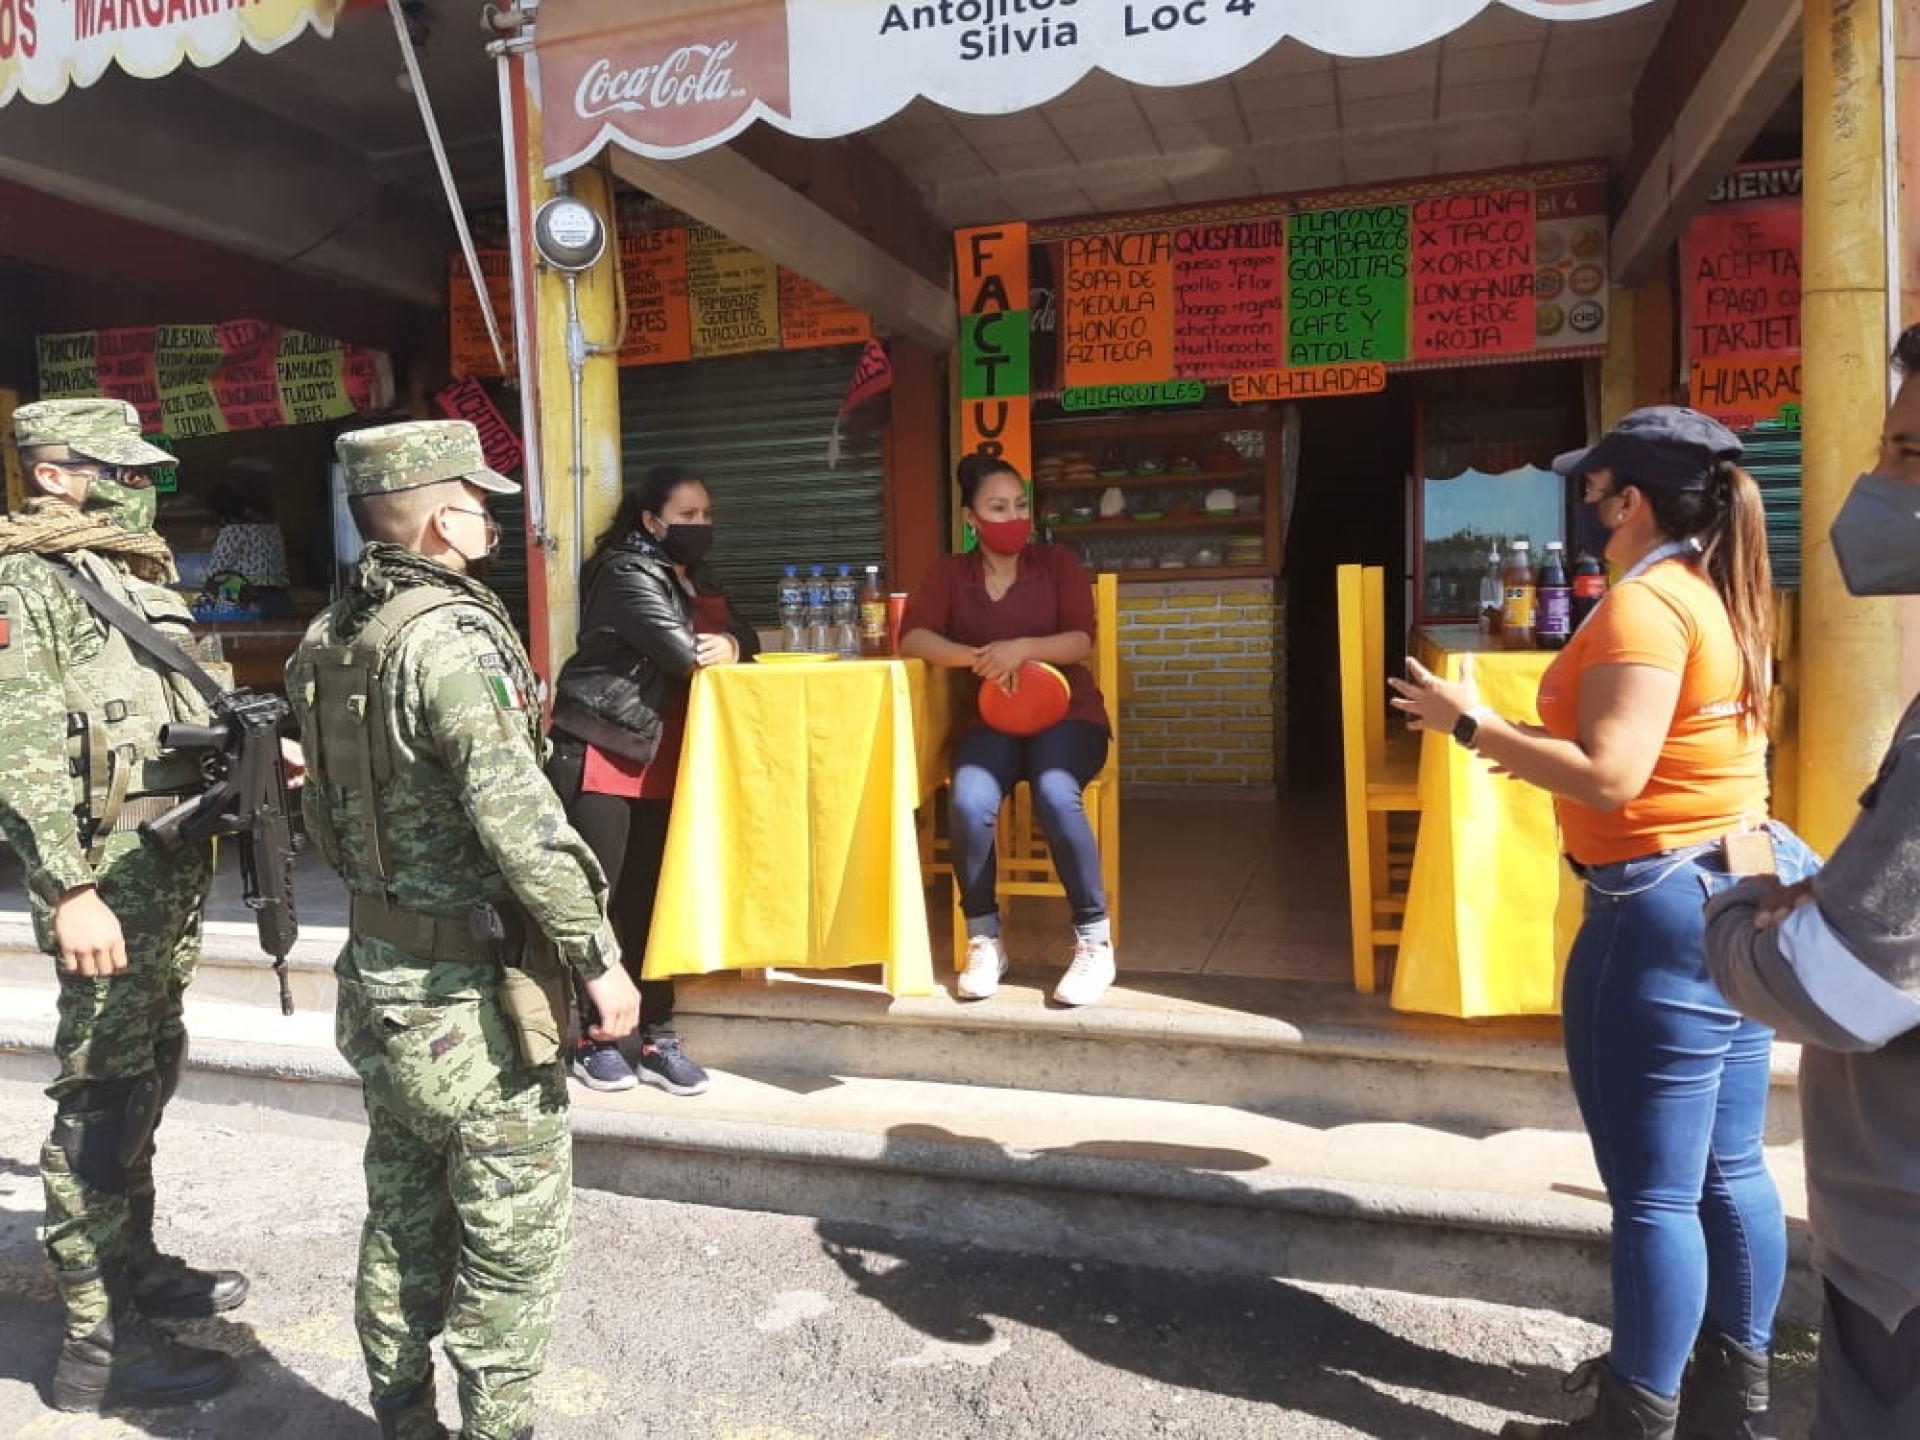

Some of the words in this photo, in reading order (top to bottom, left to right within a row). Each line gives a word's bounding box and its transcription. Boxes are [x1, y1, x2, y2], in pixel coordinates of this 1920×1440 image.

[880, 0, 1077, 34] Antojito
[1124, 1, 1206, 37] Loc
[959, 17, 1078, 60] Silvia
[1413, 189, 1530, 224] CECINA
[1290, 228, 1408, 257] PAMBAZOS
[1445, 220, 1524, 247] TACO
[1068, 231, 1170, 268] PANCITA
[1067, 268, 1121, 292] SOPA
[1128, 269, 1155, 289] DE
[1288, 253, 1407, 281] GORDITAS
[1067, 291, 1155, 318] MEDULA
[1290, 284, 1373, 310] SOPES
[1706, 286, 1767, 318] PAGO
[1290, 312, 1348, 337] CAFE
[1360, 308, 1382, 332] Y
[1435, 301, 1518, 326] VERDE
[1066, 315, 1147, 343] HONGO
[1434, 325, 1502, 351] ROJA
[1691, 314, 1801, 354] TARJET
[1066, 339, 1153, 365] AZTECA
[1290, 339, 1375, 363] ATOLE
[1063, 381, 1203, 408] CHILAQUILES
[1232, 366, 1385, 397] ENCHILADAS
